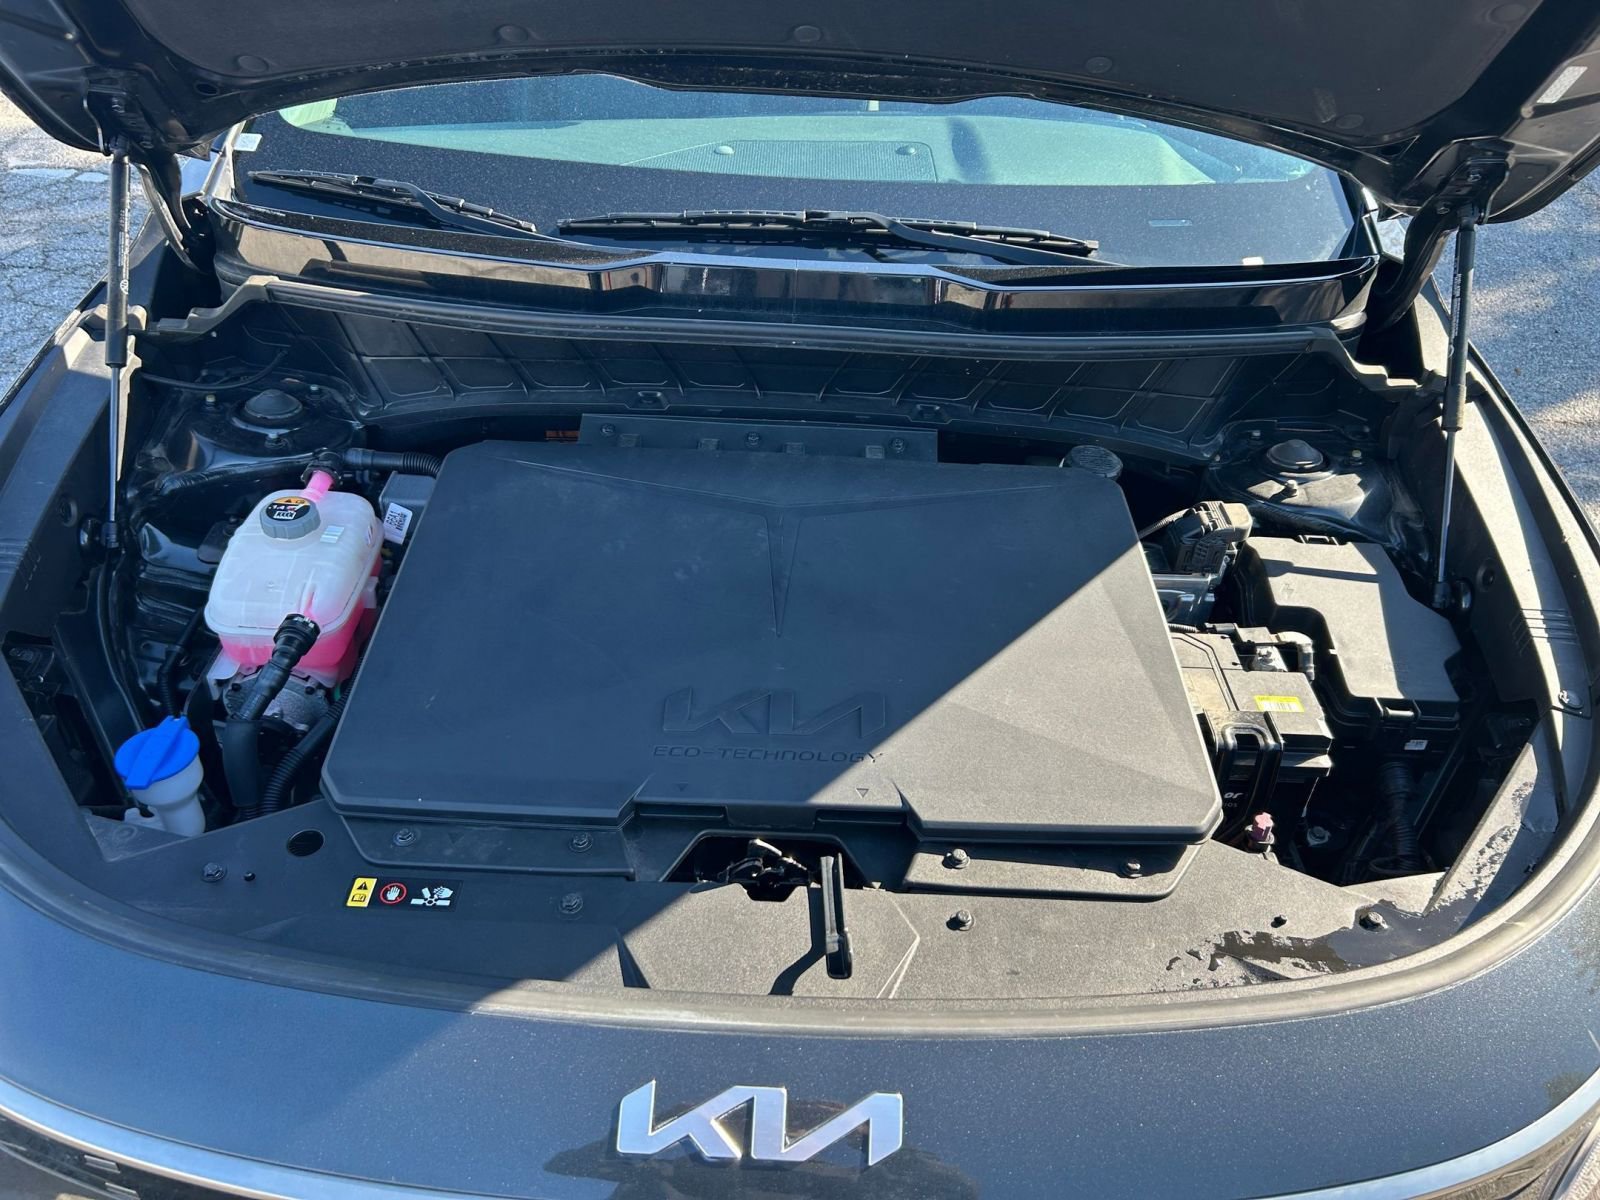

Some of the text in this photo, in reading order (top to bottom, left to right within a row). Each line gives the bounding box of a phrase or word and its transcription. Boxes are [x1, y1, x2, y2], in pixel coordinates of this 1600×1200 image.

[662, 686, 886, 738] KIA
[653, 745, 883, 764] ECO-TECHNOLOGY
[617, 1079, 904, 1167] KIA
